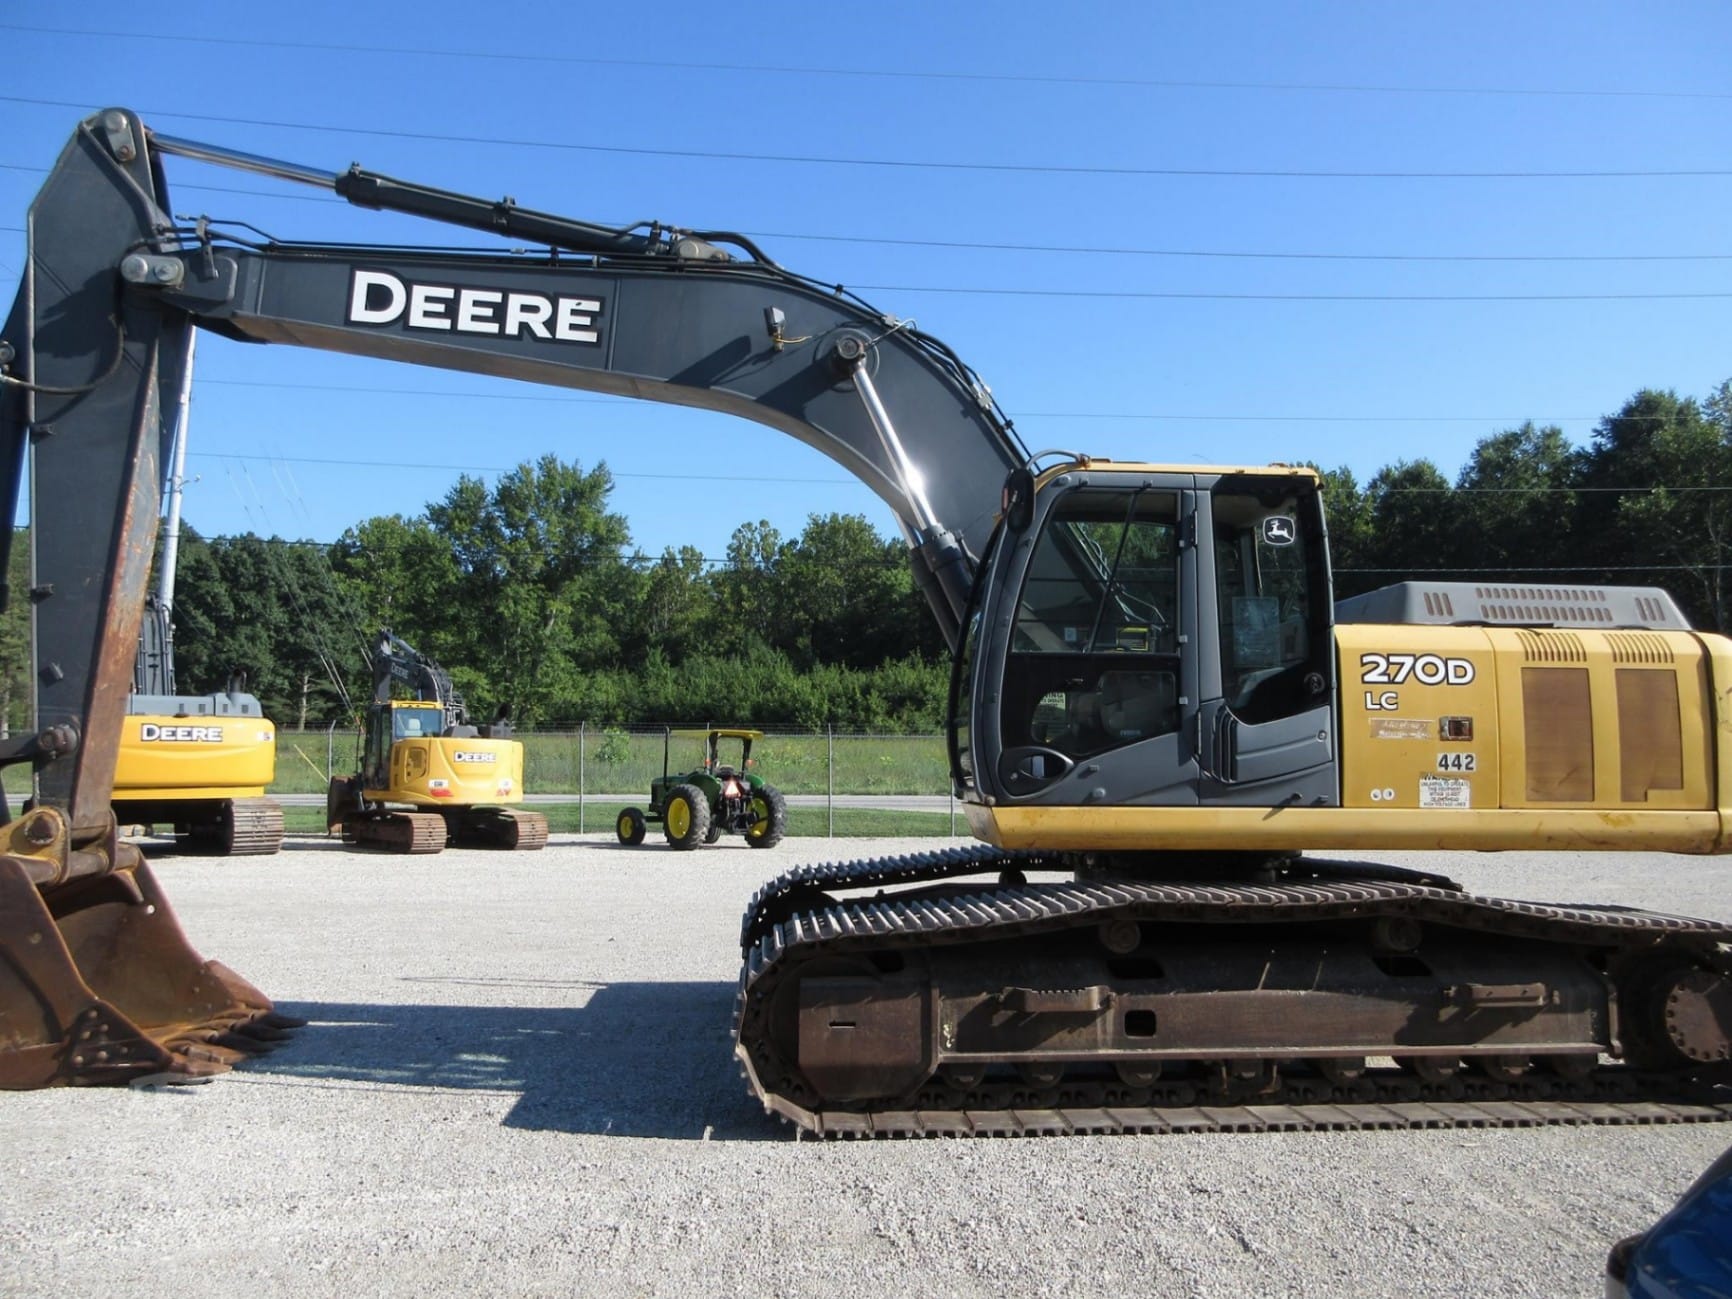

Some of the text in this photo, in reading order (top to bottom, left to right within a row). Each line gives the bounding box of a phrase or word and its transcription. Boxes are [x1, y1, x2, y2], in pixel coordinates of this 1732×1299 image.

[349, 270, 601, 343] DEERE
[1360, 653, 1476, 686] 270D
[1364, 691, 1398, 710] LC
[141, 723, 223, 742] DEERE
[454, 751, 496, 763] DEERE
[1438, 754, 1475, 770] 442
